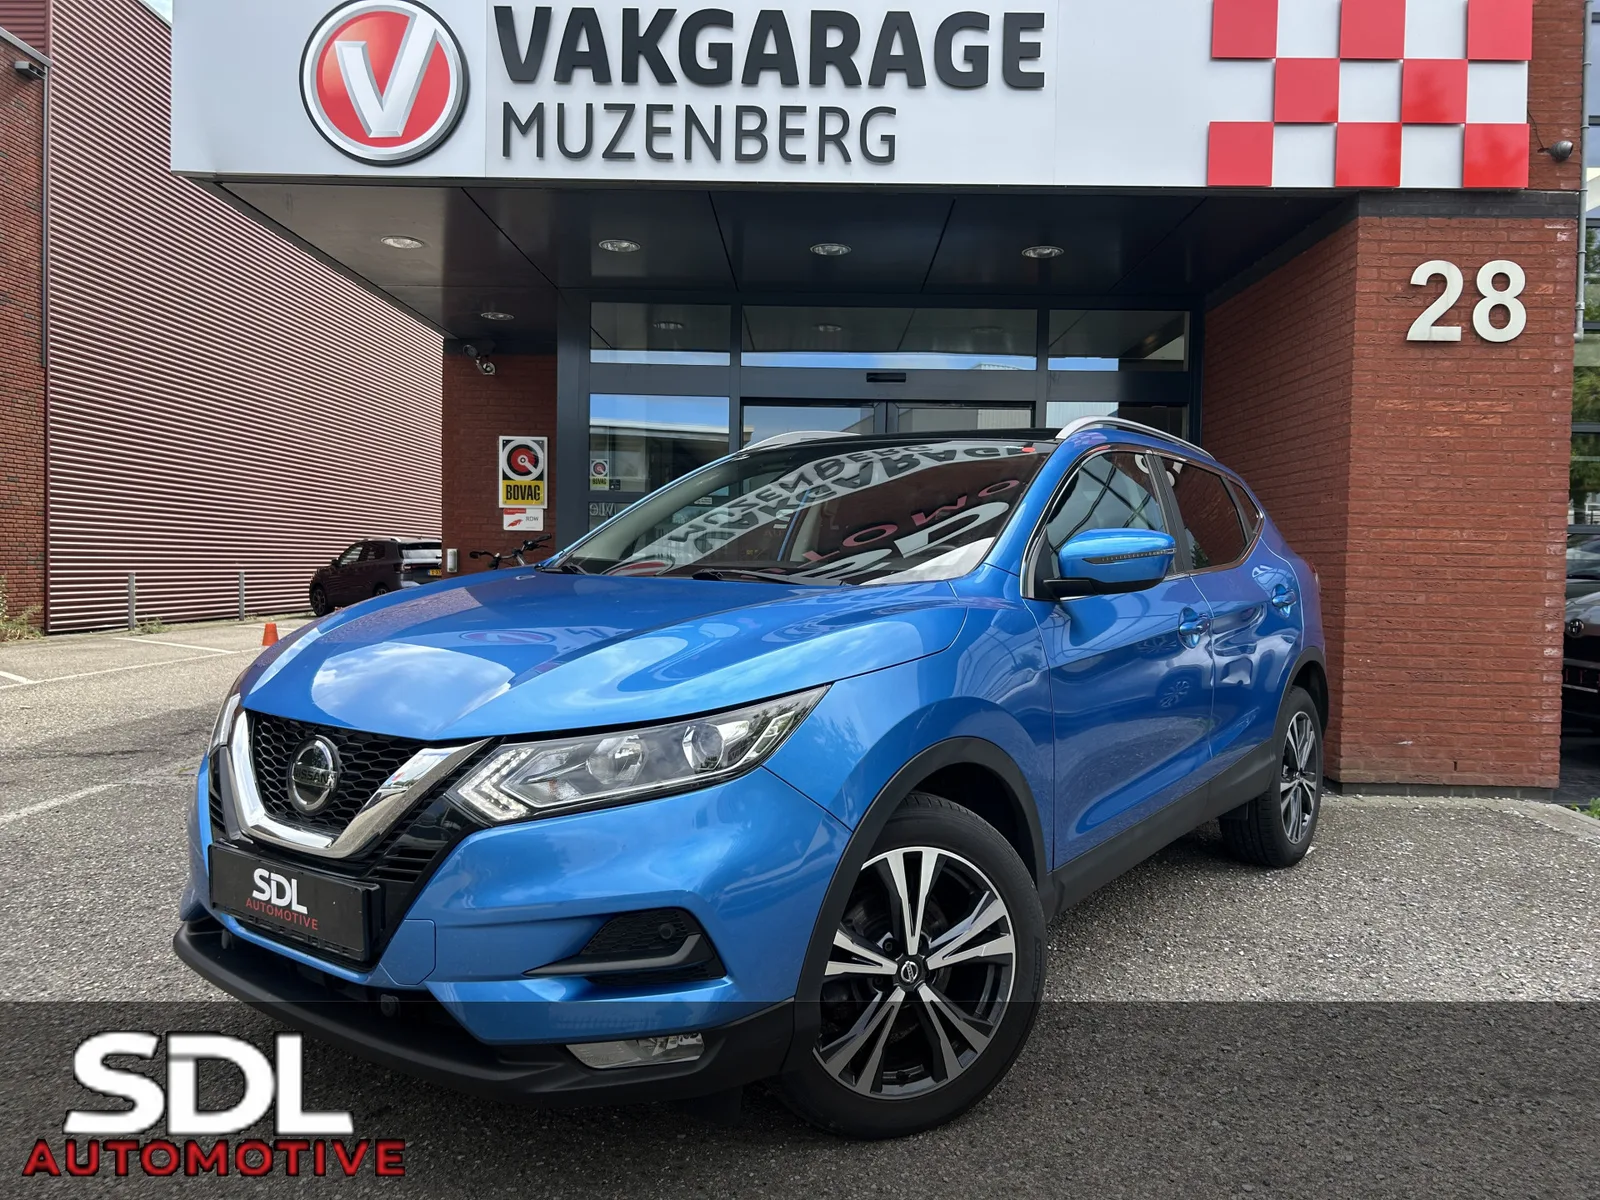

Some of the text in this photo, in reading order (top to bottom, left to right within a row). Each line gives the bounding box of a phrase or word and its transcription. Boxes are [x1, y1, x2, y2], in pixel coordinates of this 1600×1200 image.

[494, 6, 1045, 91] VAKGARAGE
[502, 102, 897, 164] MUZENBERG
[1406, 259, 1527, 343] 28
[505, 484, 540, 501] BOVAG
[295, 767, 329, 784] NISSAN
[245, 898, 318, 931] AUTOMOTIVE
[252, 868, 308, 915] SDL
